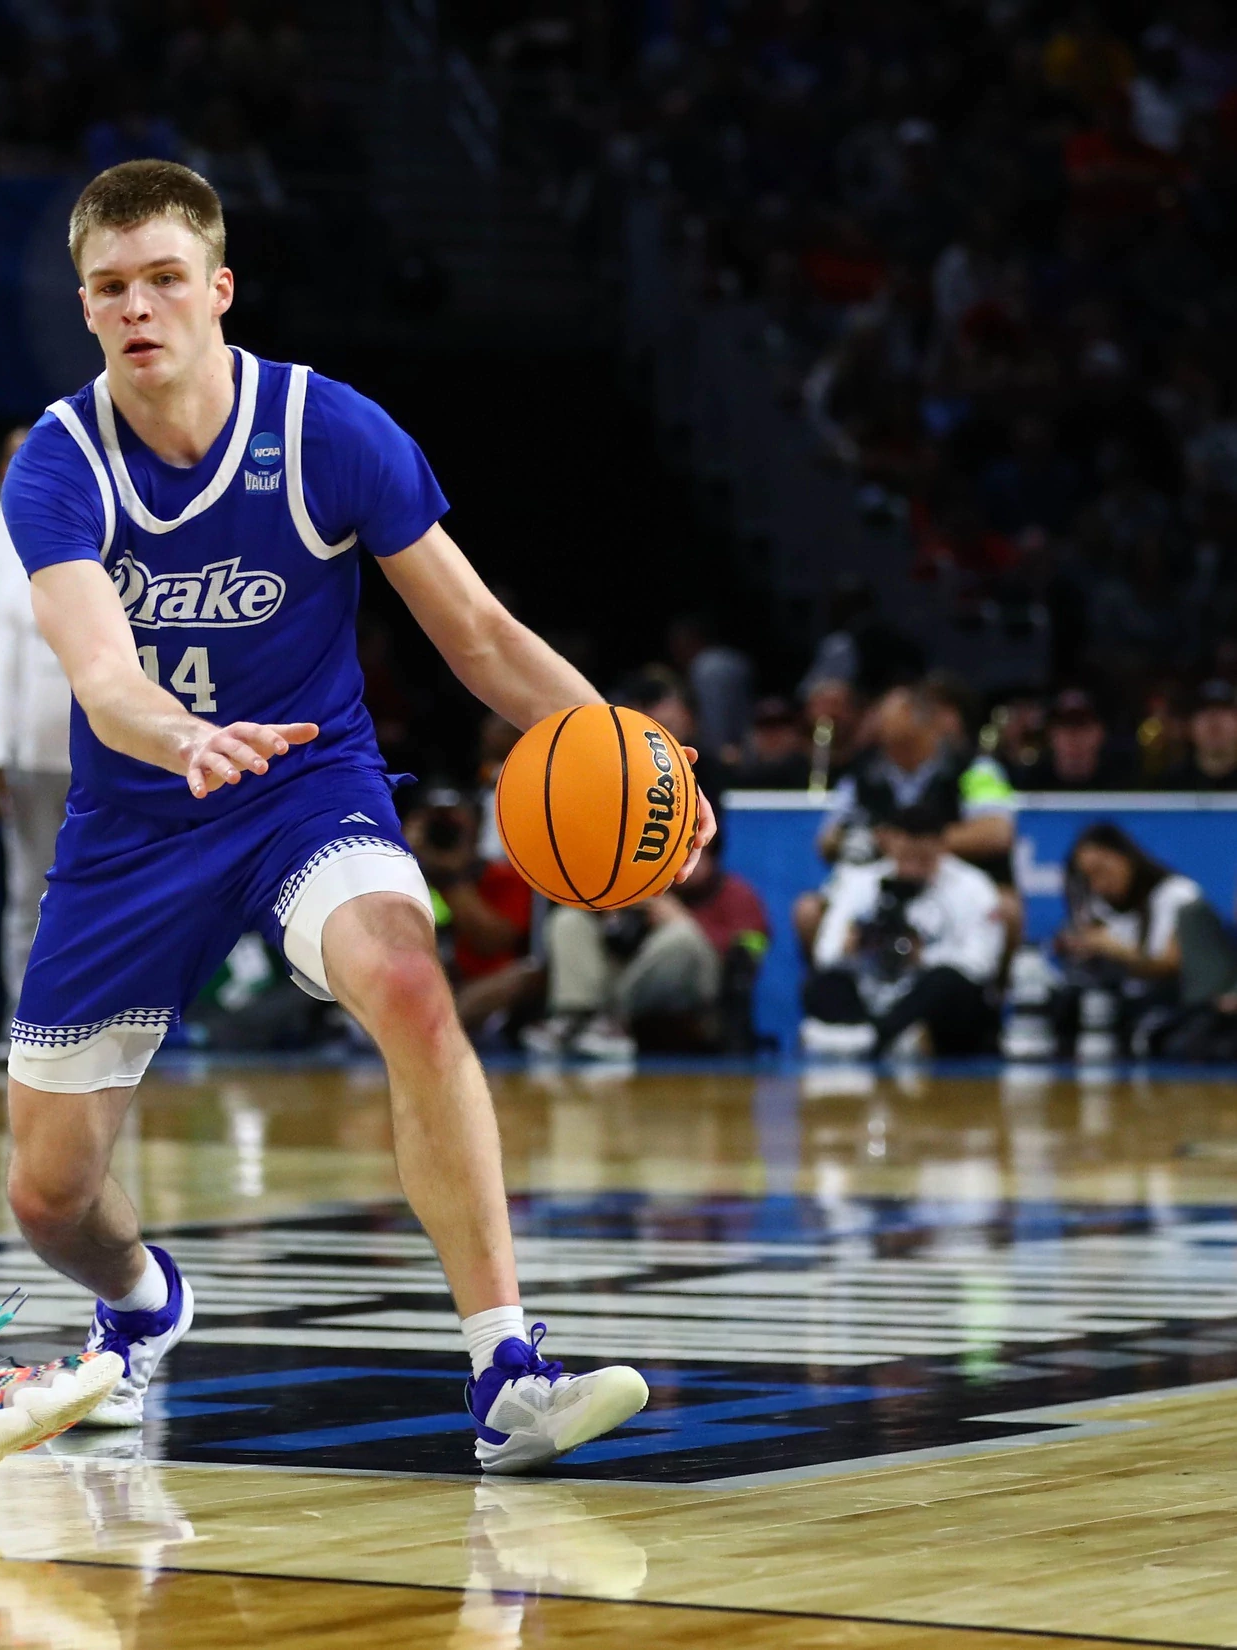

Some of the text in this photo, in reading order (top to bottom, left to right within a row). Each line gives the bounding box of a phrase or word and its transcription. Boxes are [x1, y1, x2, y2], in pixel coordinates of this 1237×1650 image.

[254, 447, 281, 458] NCAA
[244, 468, 282, 491] VALLEY
[110, 551, 285, 627] Drake
[631, 730, 675, 863] Wilson
